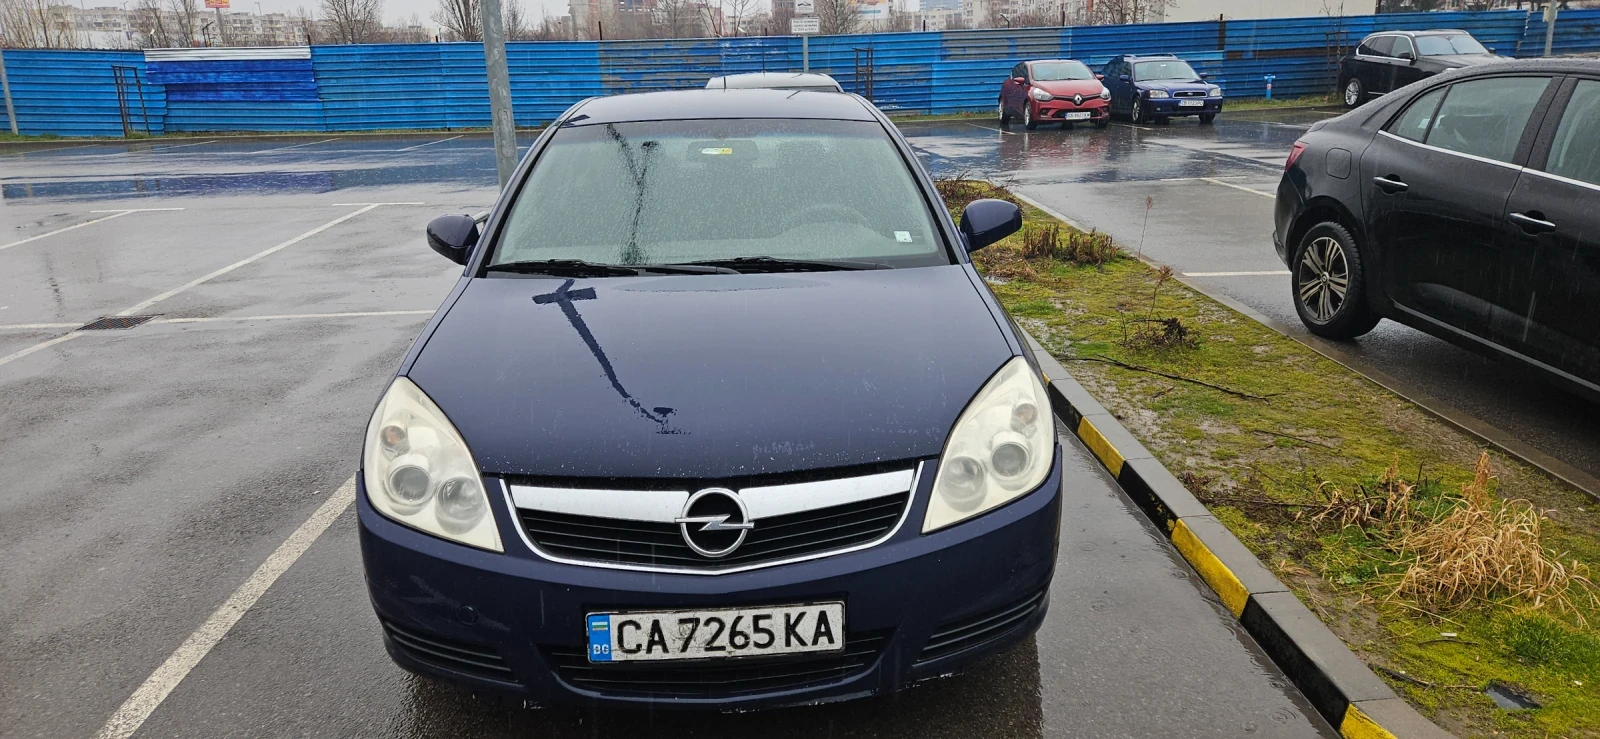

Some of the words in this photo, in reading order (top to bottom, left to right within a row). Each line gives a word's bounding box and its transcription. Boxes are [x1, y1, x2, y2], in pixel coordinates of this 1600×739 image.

[617, 619, 670, 654] CA
[678, 613, 776, 653] 7265
[784, 610, 835, 648] KA
[593, 643, 610, 655] BG
